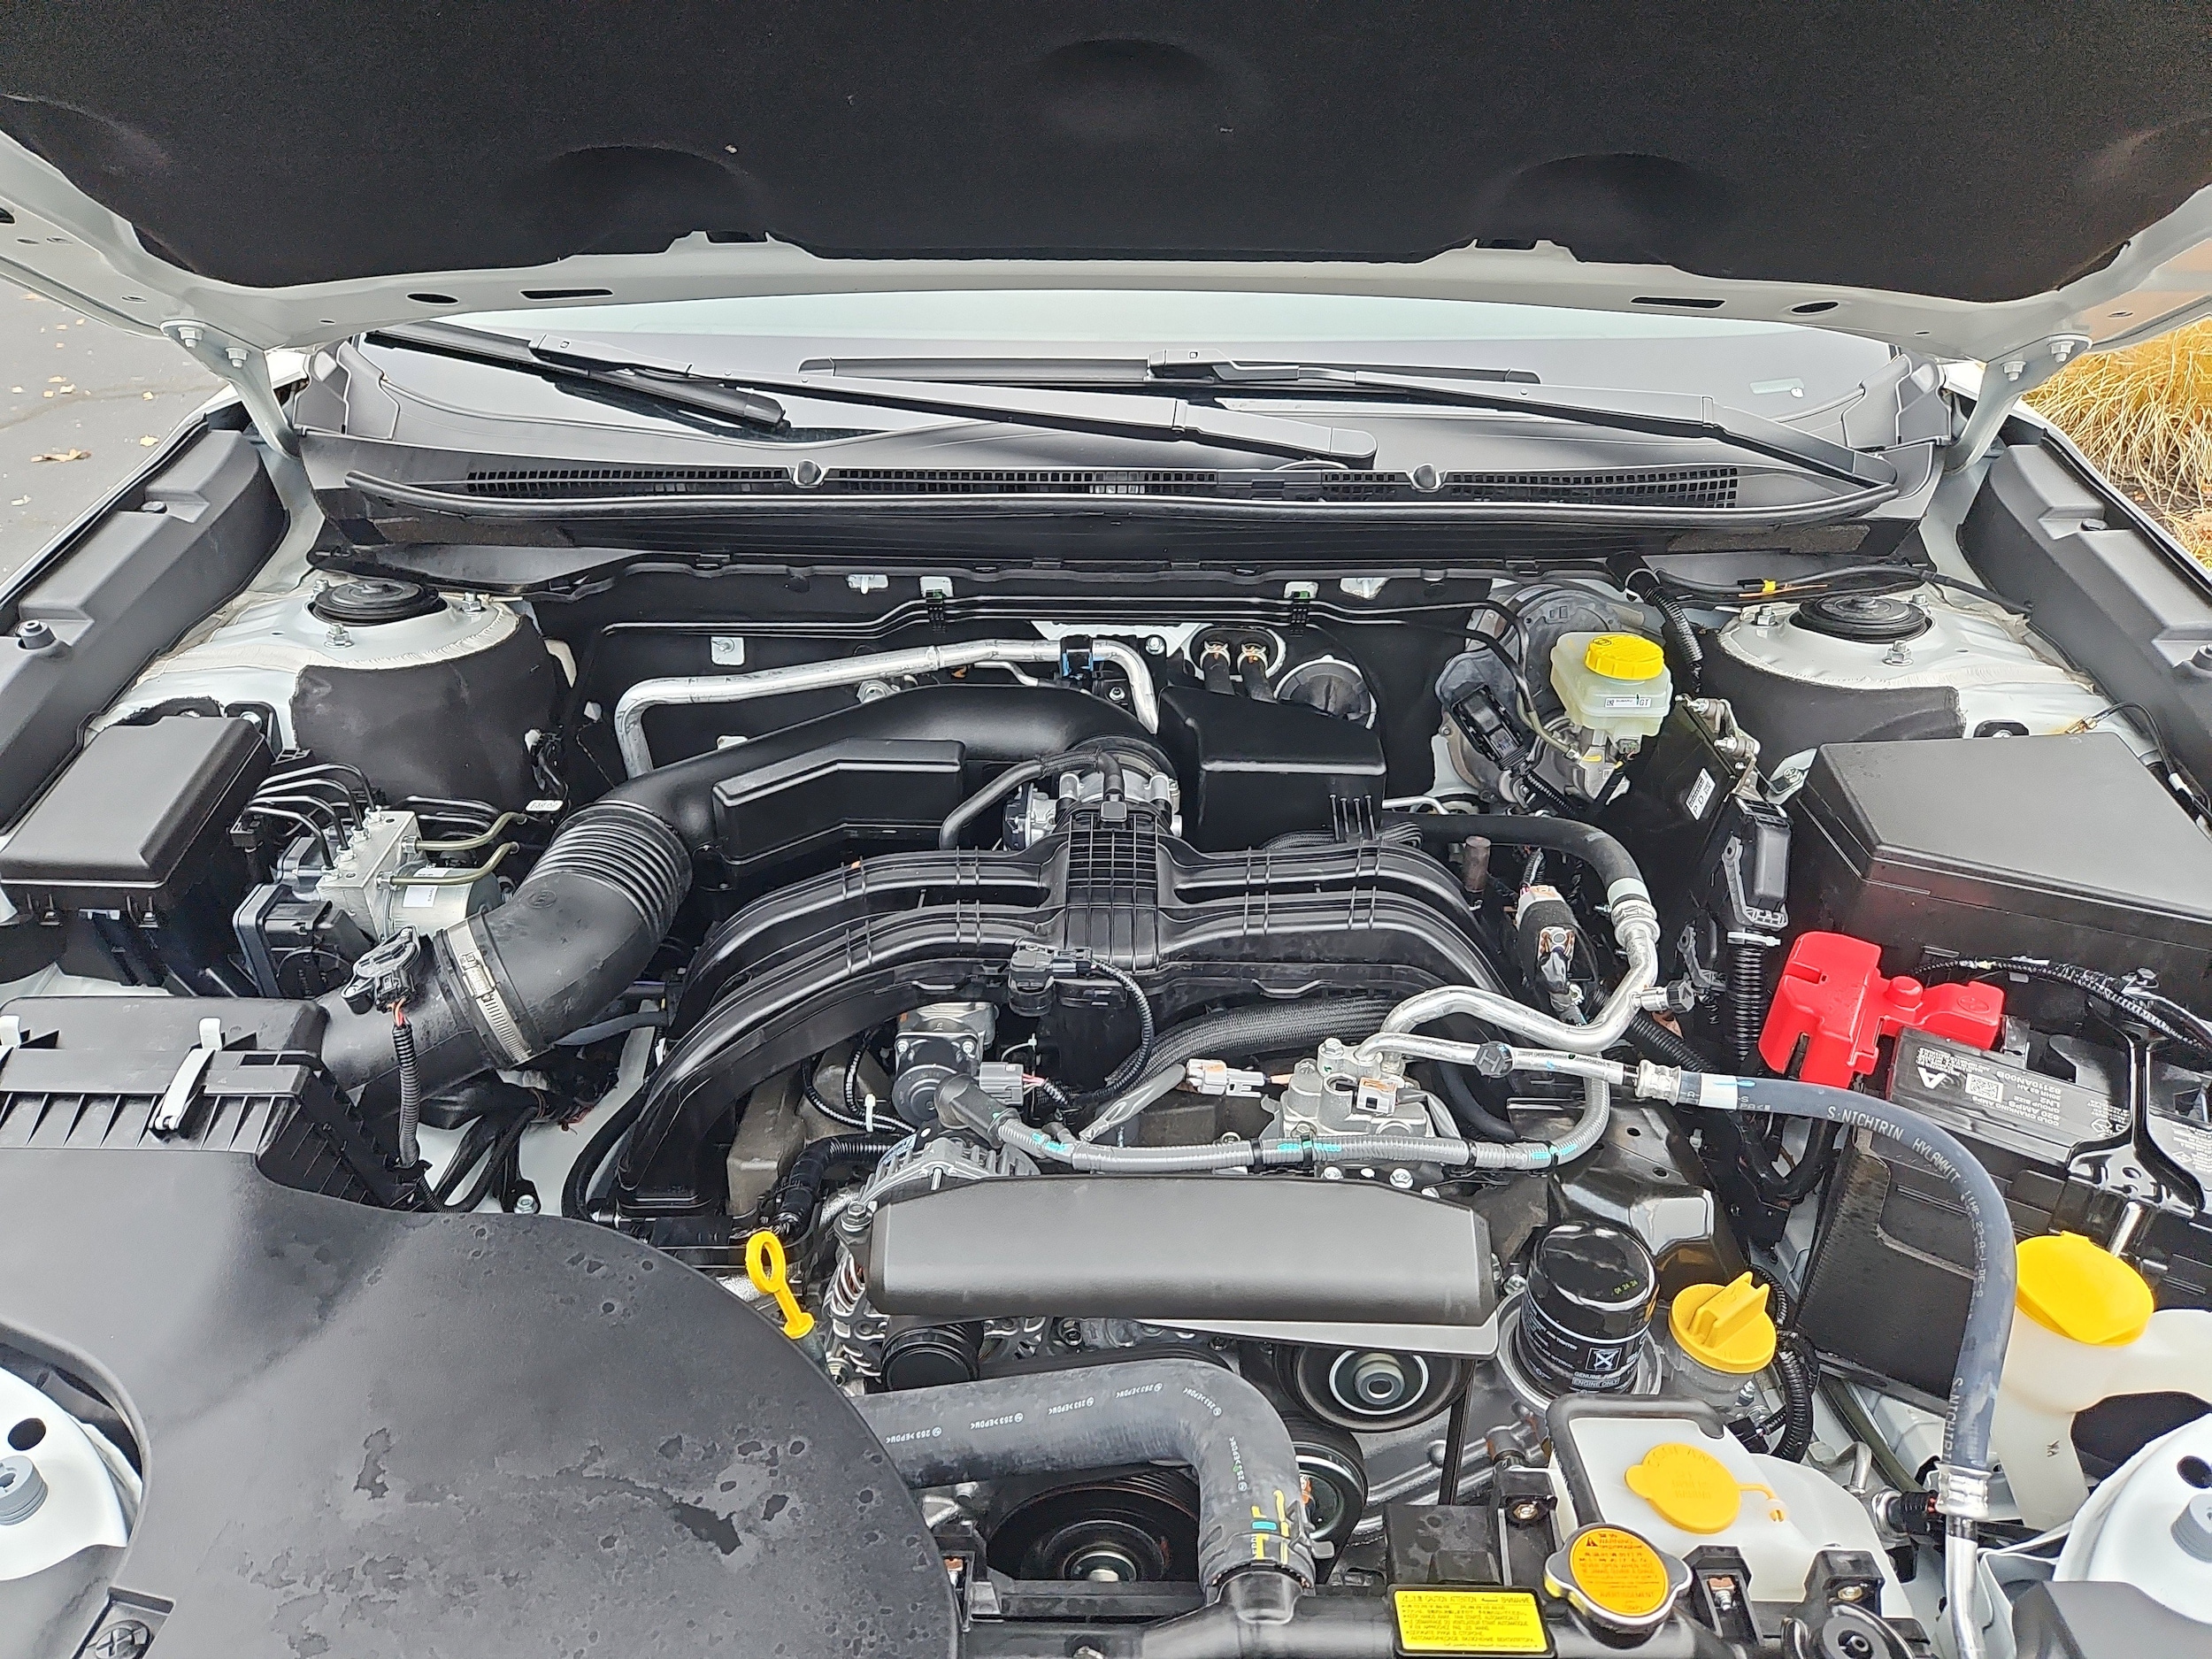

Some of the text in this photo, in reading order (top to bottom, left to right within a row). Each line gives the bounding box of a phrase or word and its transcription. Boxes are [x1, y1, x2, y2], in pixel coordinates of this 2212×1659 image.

[1997, 1071, 2062, 1094] 82110AN00B
[2017, 1084, 2031, 1094] AH
[2008, 1101, 2040, 1115] AMPS
[2032, 1102, 2060, 1113] GROUP
[2039, 1097, 2060, 1108] LN2
[1971, 1095, 2059, 1126] COLD CRANKING AMPS
[1574, 1371, 1601, 1380] GENUINE
[1573, 1379, 1619, 1387] ENGINE ONLY
